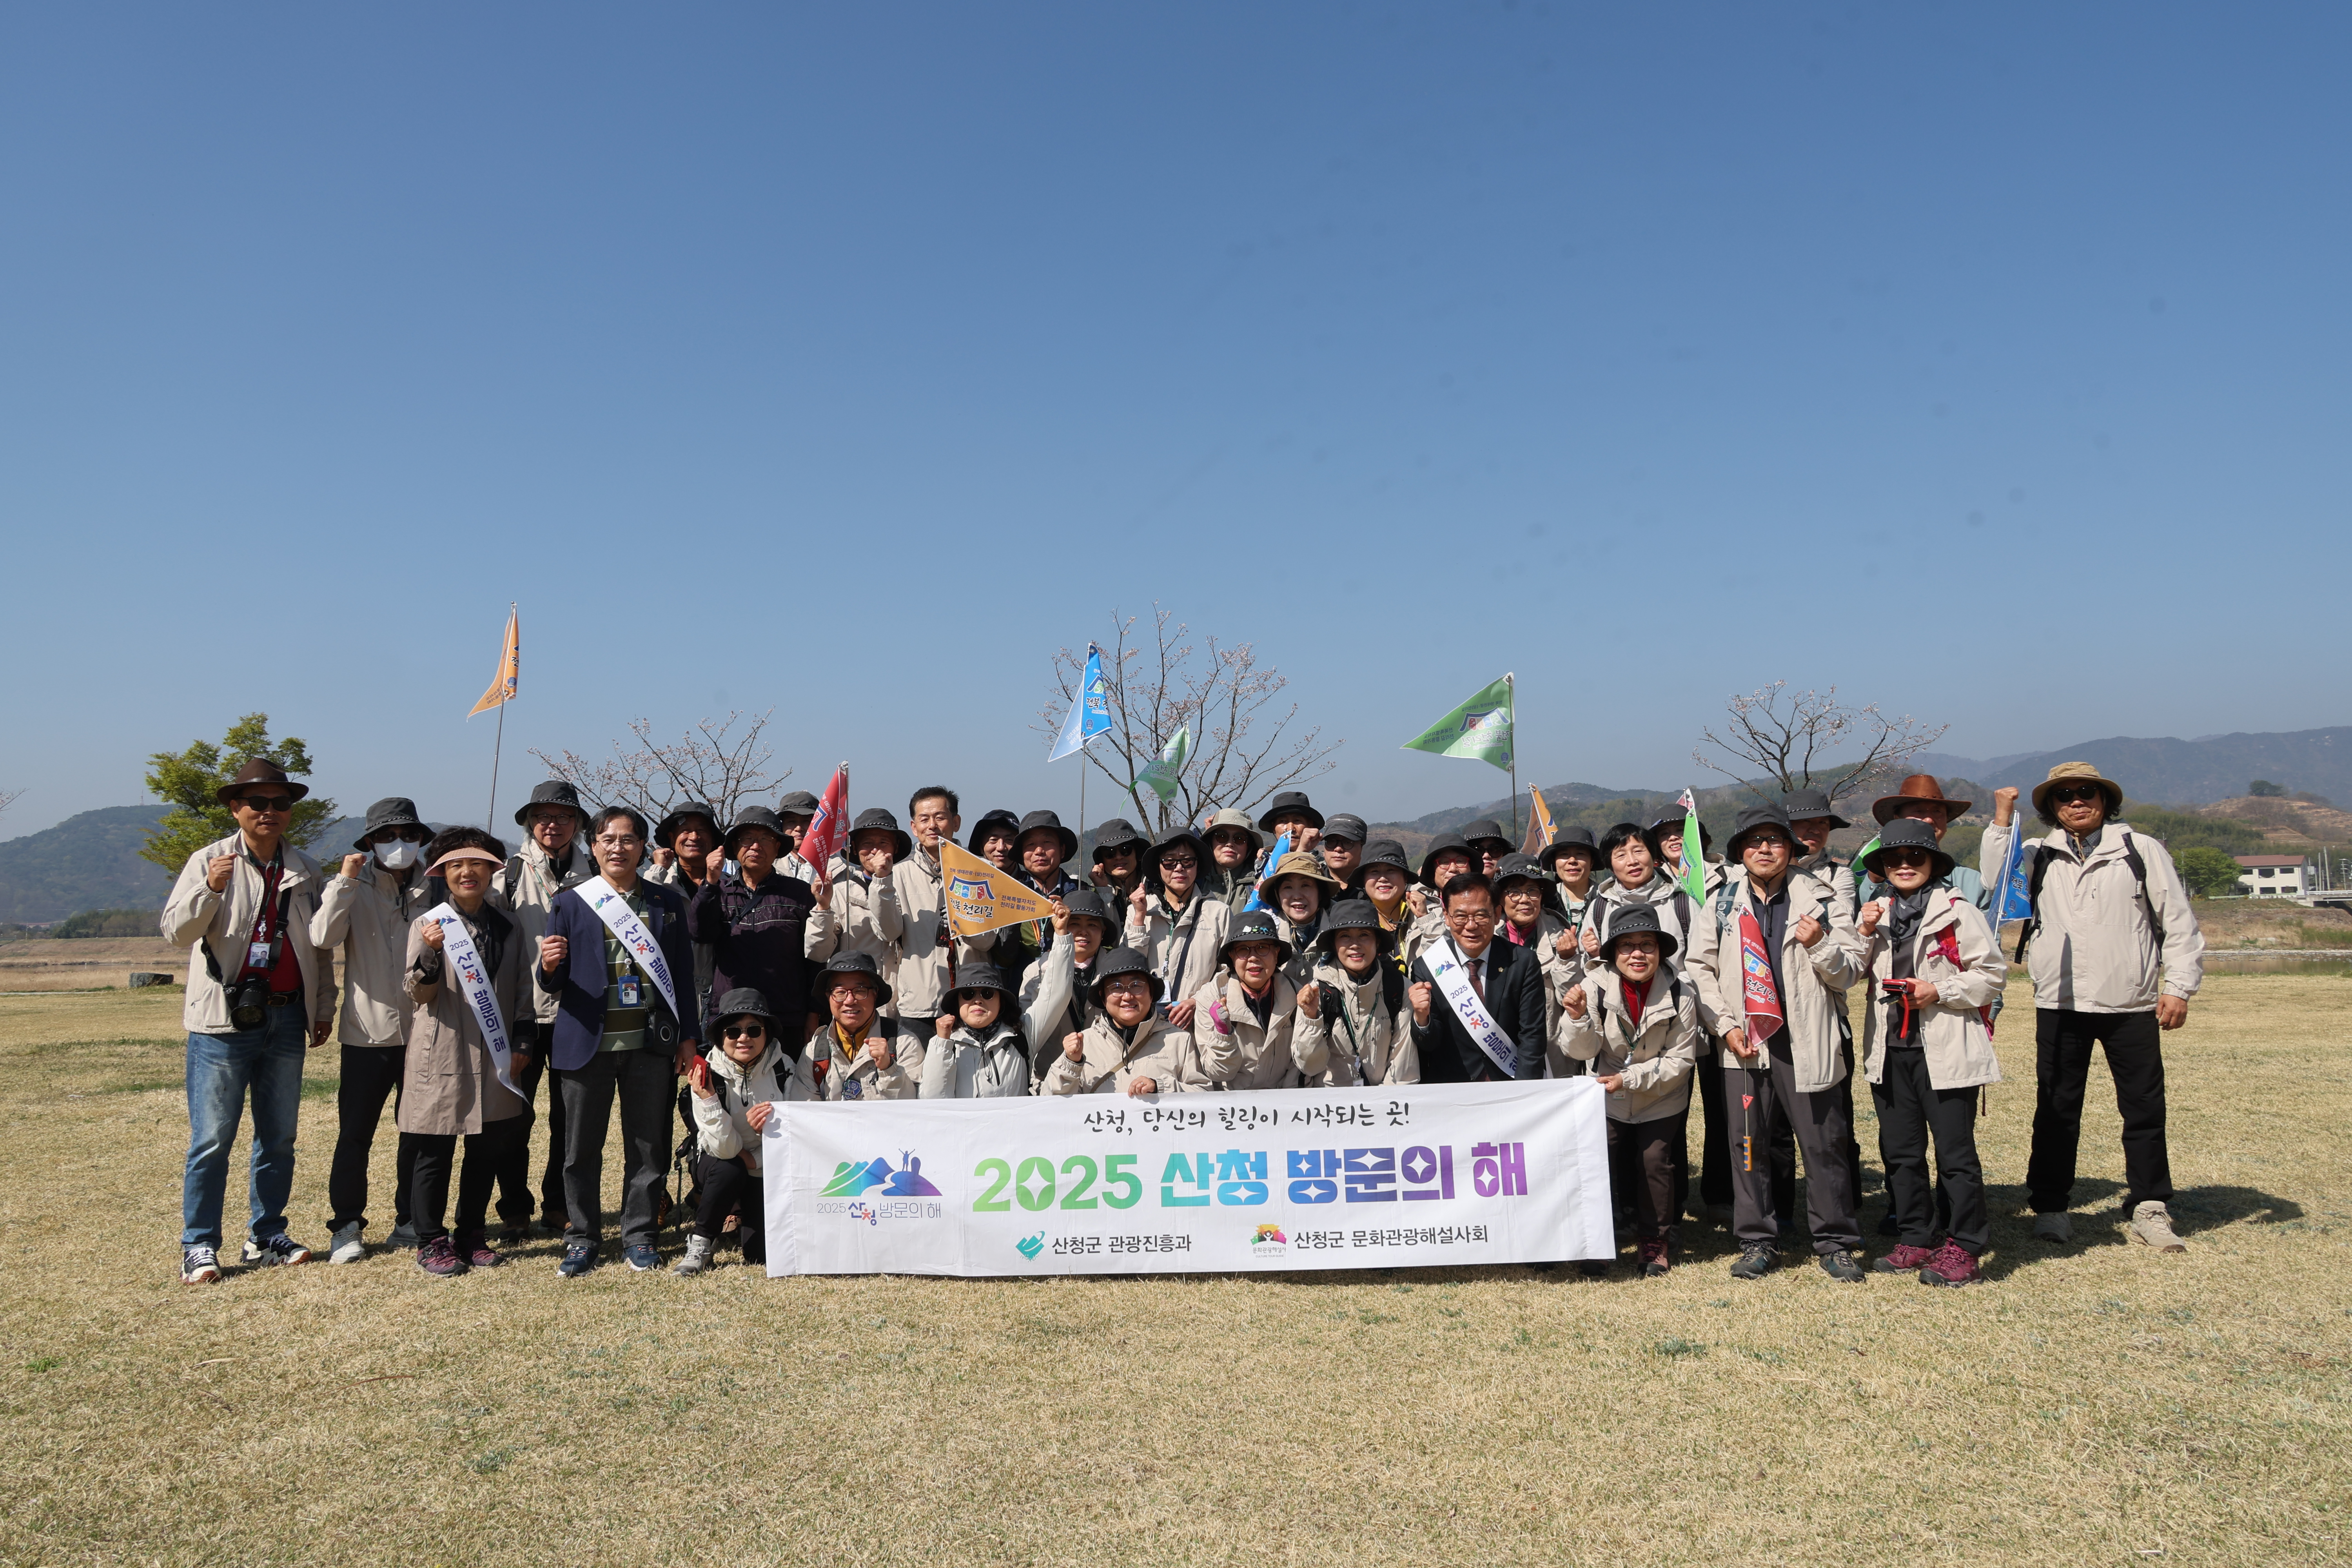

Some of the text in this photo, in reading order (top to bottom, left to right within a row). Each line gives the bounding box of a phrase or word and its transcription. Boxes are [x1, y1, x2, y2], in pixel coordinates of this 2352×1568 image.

[1086, 697, 1100, 709] 전북
[949, 897, 993, 918] 전북 천리길
[1002, 895, 1036, 906] 전북특별자치도
[1016, 904, 1036, 913] 활동가회
[613, 913, 632, 928] 2025
[449, 939, 469, 951] 2025
[625, 923, 674, 998] 산청 방문의
[1450, 985, 1468, 999] 2025
[1746, 976, 1775, 1004] 천리길
[457, 951, 506, 1052] 산청 방문의 해
[1460, 996, 1489, 1030] 산청
[1483, 1031, 1512, 1063] 방문의
[1084, 1101, 1409, 1135] 산청, 당신의 힐링이 시작되는 곳!
[973, 1142, 1528, 1212] 2025 산청 방문의 해
[817, 1202, 941, 1226] 2025 산청 방문의 해
[1052, 1234, 1192, 1254] 산청군 관광진흥과
[1294, 1225, 1488, 1249] 산청군 문화관광해설사회
